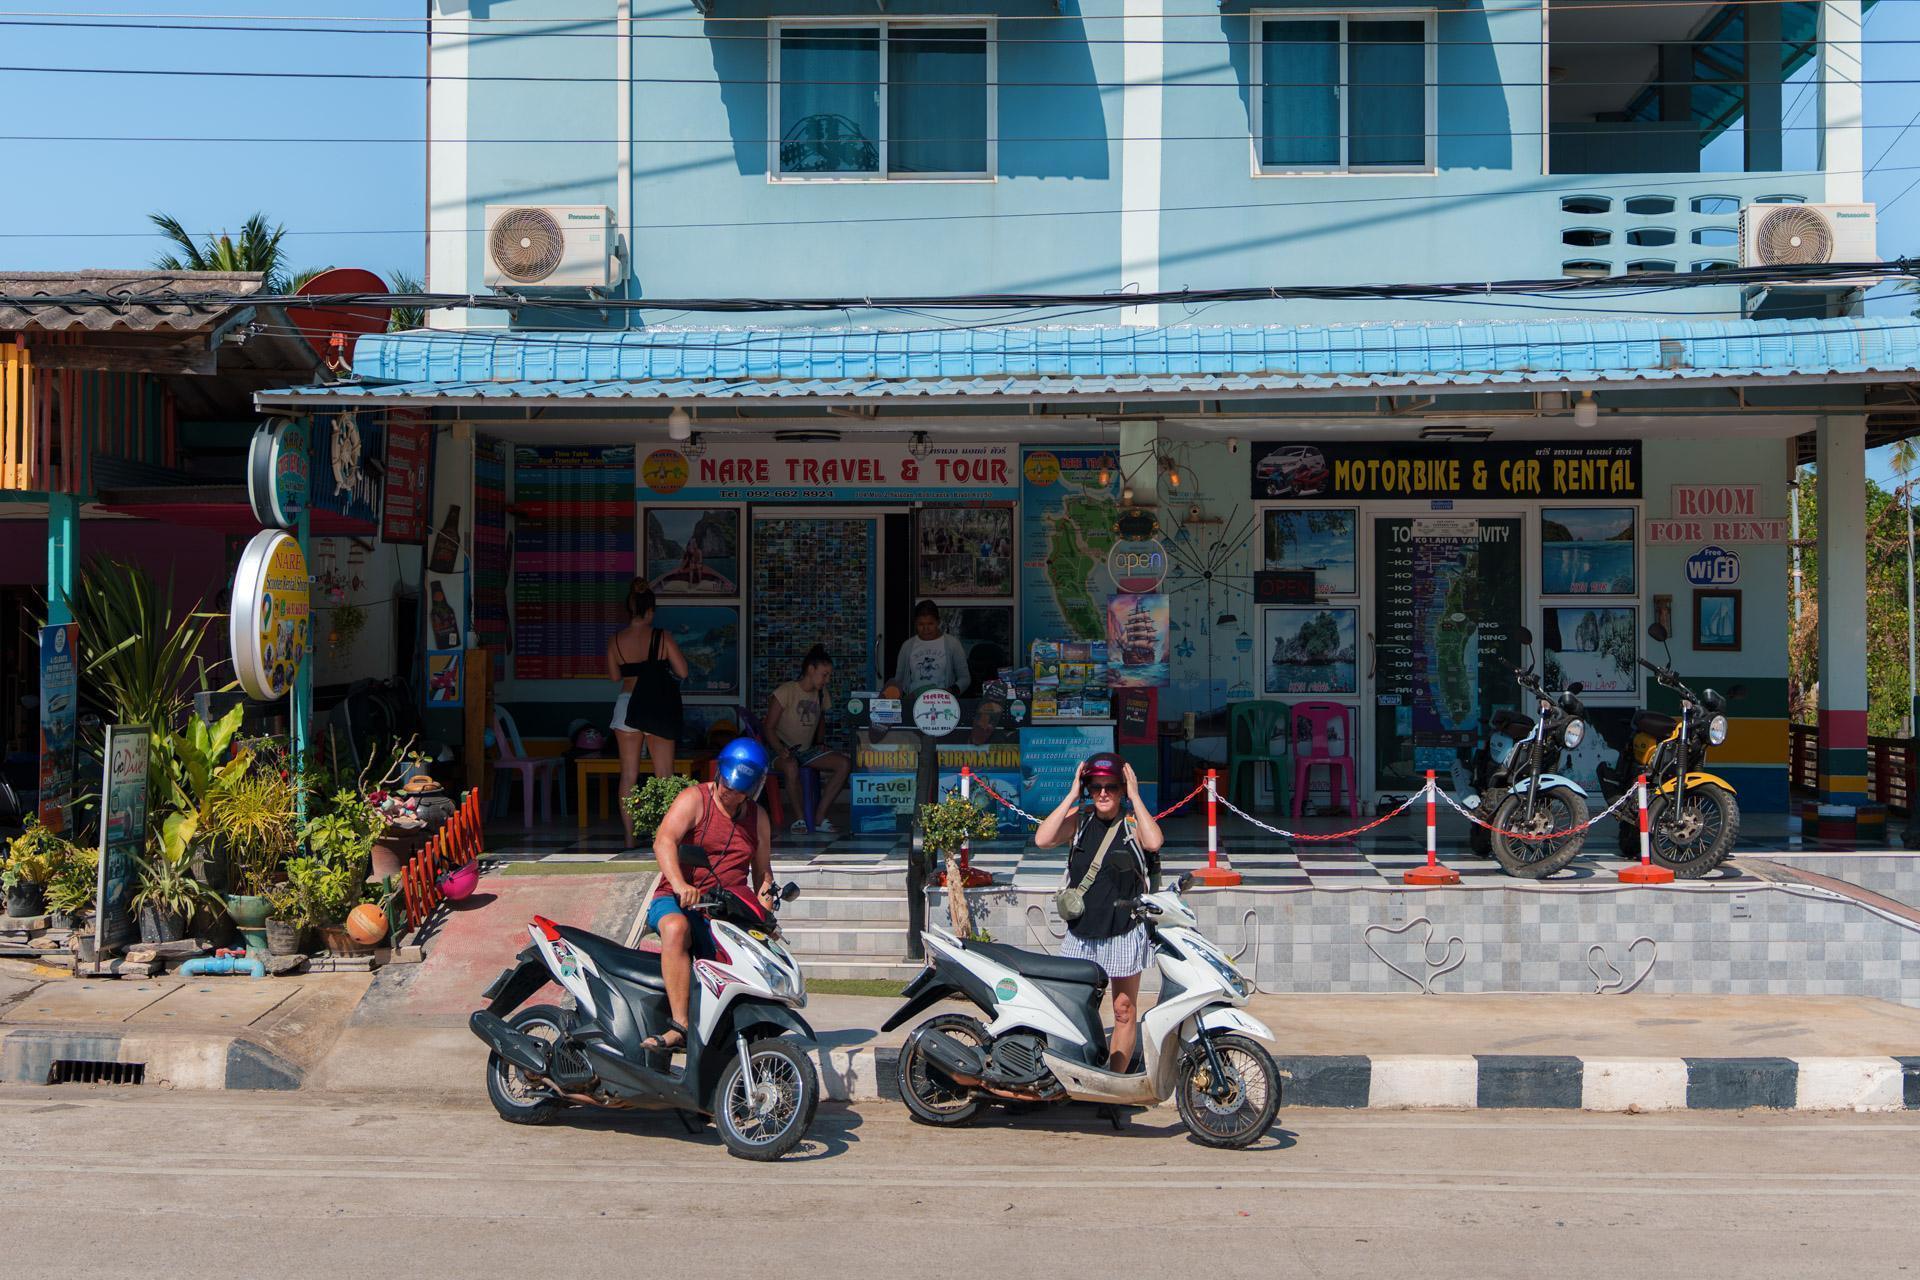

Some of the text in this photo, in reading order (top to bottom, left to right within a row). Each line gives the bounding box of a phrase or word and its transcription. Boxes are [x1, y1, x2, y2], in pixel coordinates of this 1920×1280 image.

[700, 459, 1009, 486] NARE TRAVEL & TOUR
[1335, 459, 1636, 494] MOTORBIKE & CAR RENTAL
[1679, 488, 1755, 515] ROOM
[1391, 526, 1510, 543] TO IVITY
[1650, 522, 1784, 541] FOR RENT
[274, 552, 305, 570] NARE
[1704, 549, 1722, 557] Free
[1114, 552, 1163, 577] open
[1260, 579, 1308, 596] OPEN
[922, 692, 951, 700] NARE
[857, 751, 1020, 769] TOURIST FORMATION
[856, 779, 912, 792] Travel
[856, 795, 912, 804] and Tour
